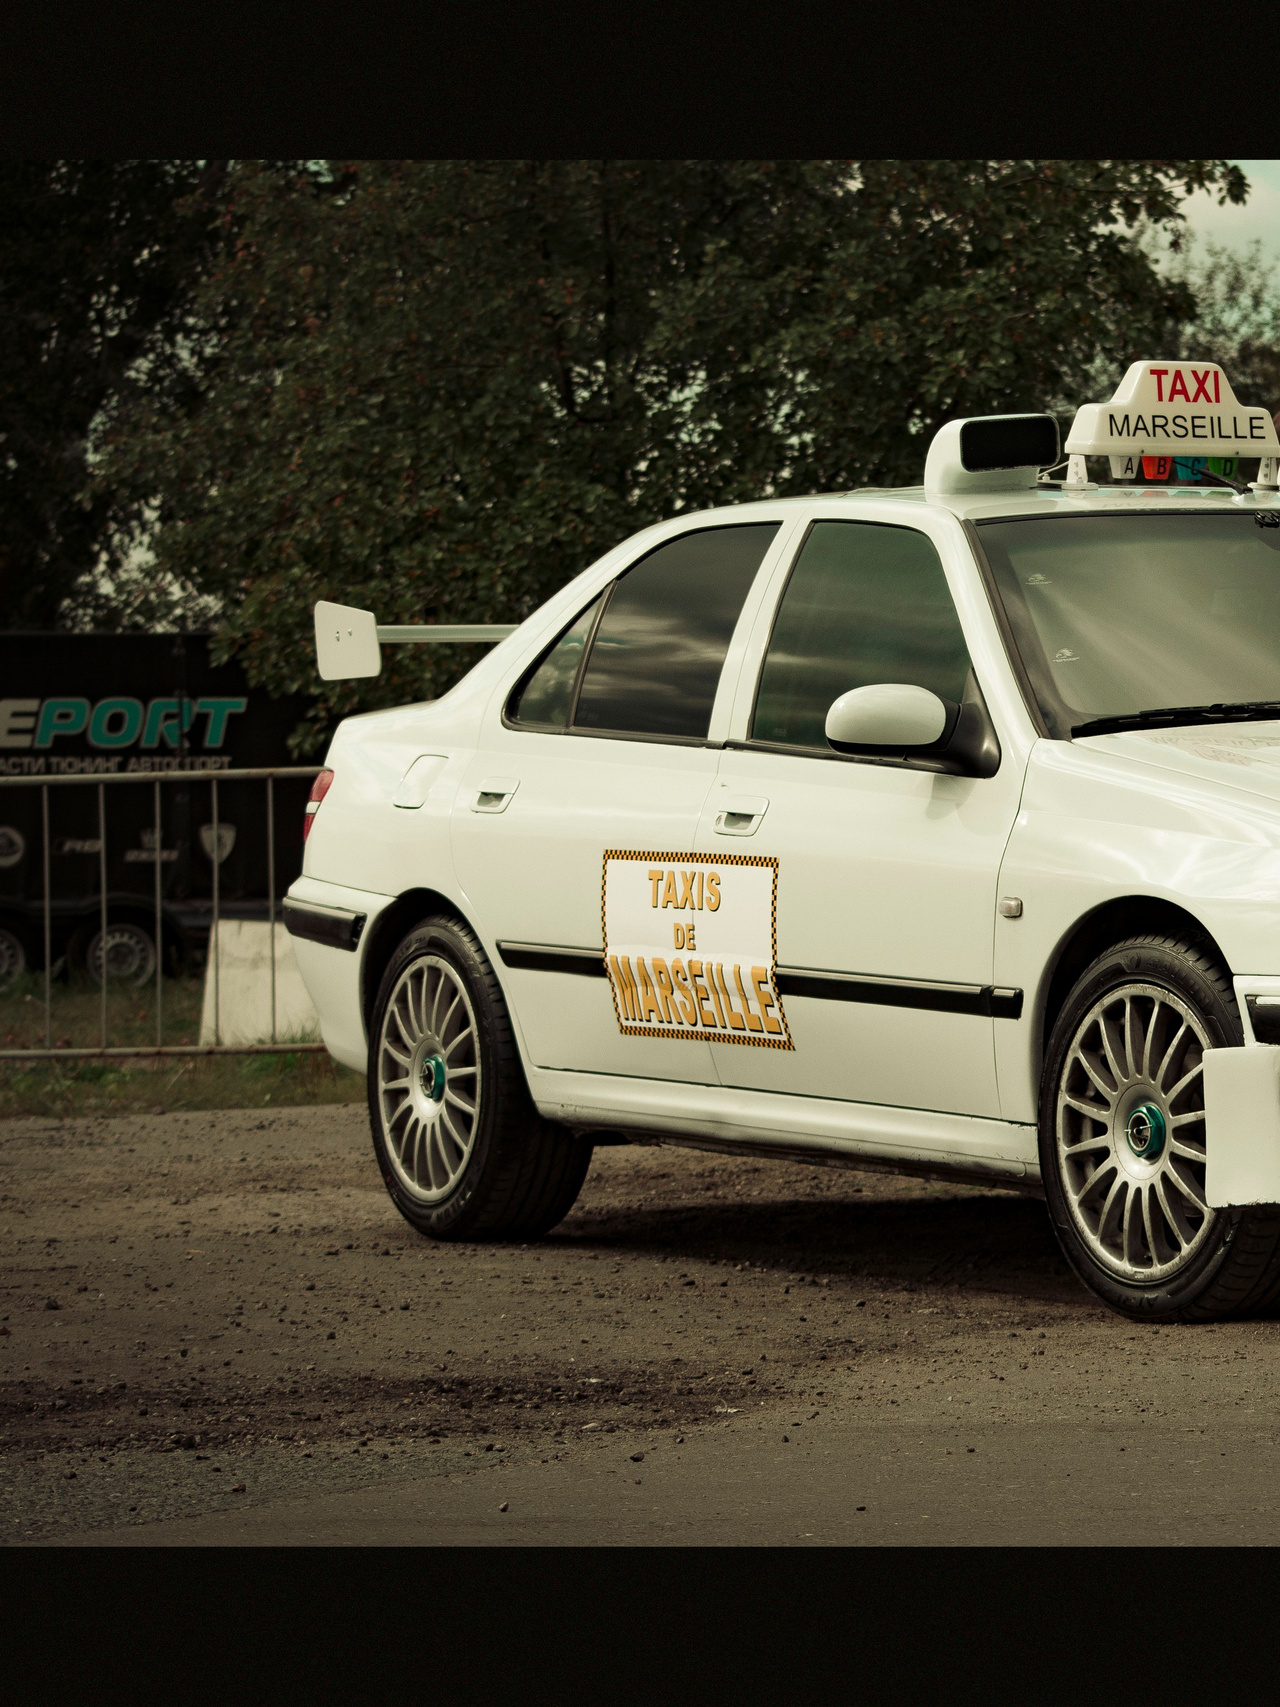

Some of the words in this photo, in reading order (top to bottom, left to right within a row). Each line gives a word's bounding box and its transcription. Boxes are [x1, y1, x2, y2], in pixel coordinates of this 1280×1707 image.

[1150, 369, 1221, 403] TAXI
[1109, 413, 1266, 441] MARSEILLE
[1124, 457, 1134, 475] A
[1156, 457, 1167, 475] B
[1223, 459, 1233, 476] D
[48, 756, 123, 773] ТЮНИНГ
[648, 869, 721, 912] TAXIS
[673, 923, 696, 950] DE
[609, 954, 784, 1036] MARSEILLE
